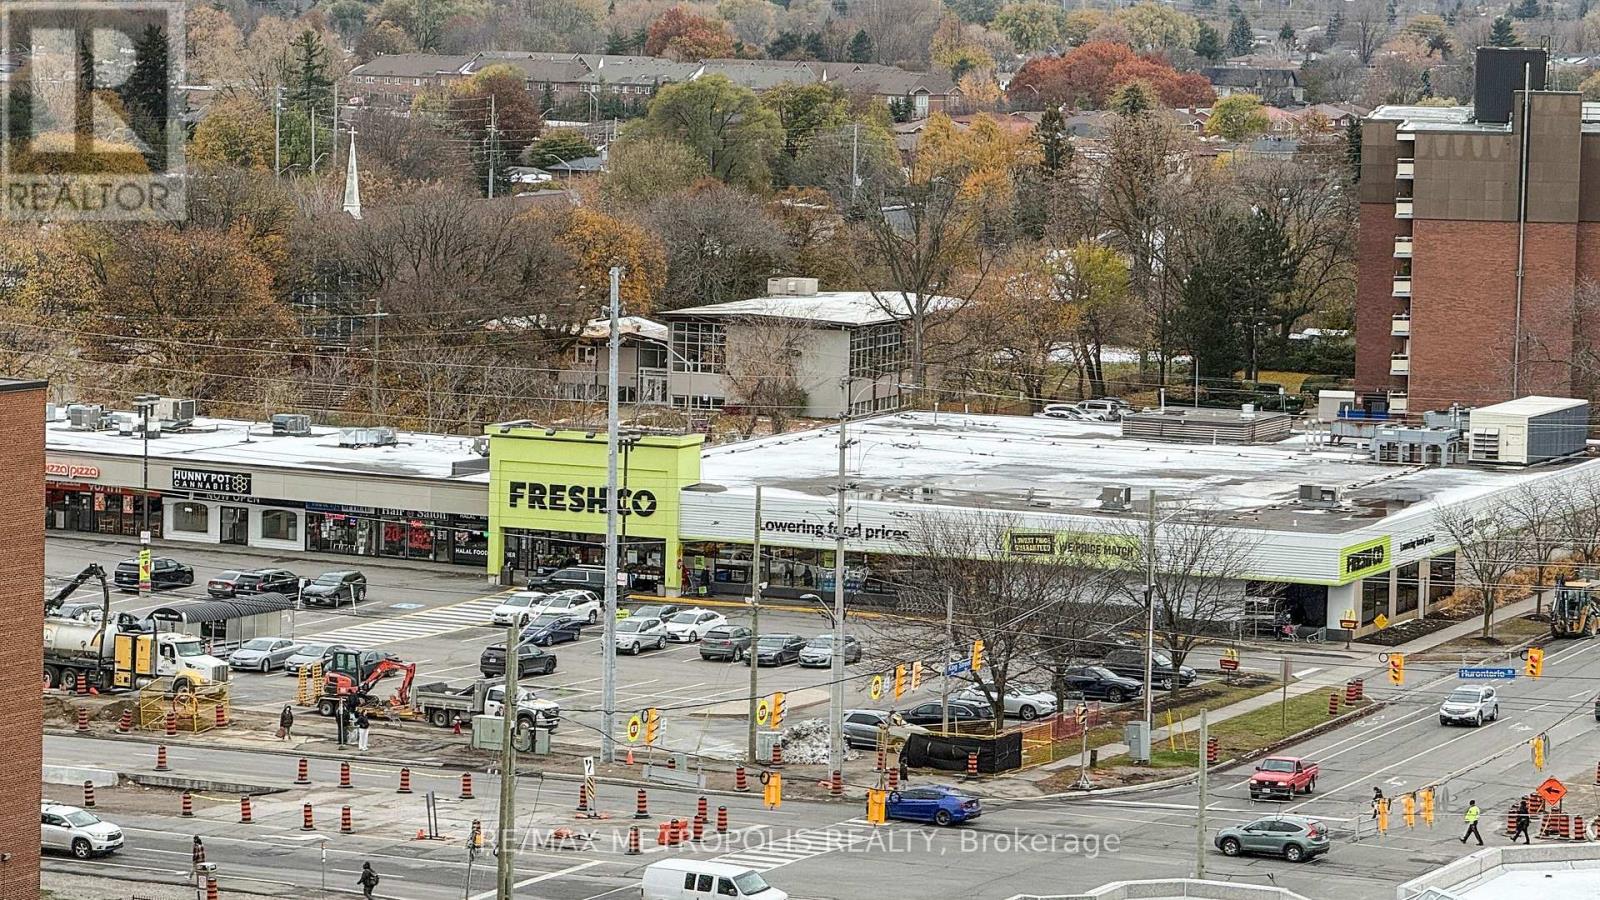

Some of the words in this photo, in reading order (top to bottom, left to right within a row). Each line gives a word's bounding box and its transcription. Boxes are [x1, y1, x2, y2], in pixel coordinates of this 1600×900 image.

[46, 463, 68, 475] izza
[69, 465, 99, 478] pizza
[173, 469, 208, 482] HUNNY
[211, 474, 231, 483] POT
[174, 480, 230, 491] CANNABIS
[759, 517, 824, 536] Lowering
[865, 525, 909, 540] prices
[455, 547, 473, 555] HALAL
[1461, 669, 1505, 679] Hurontario
